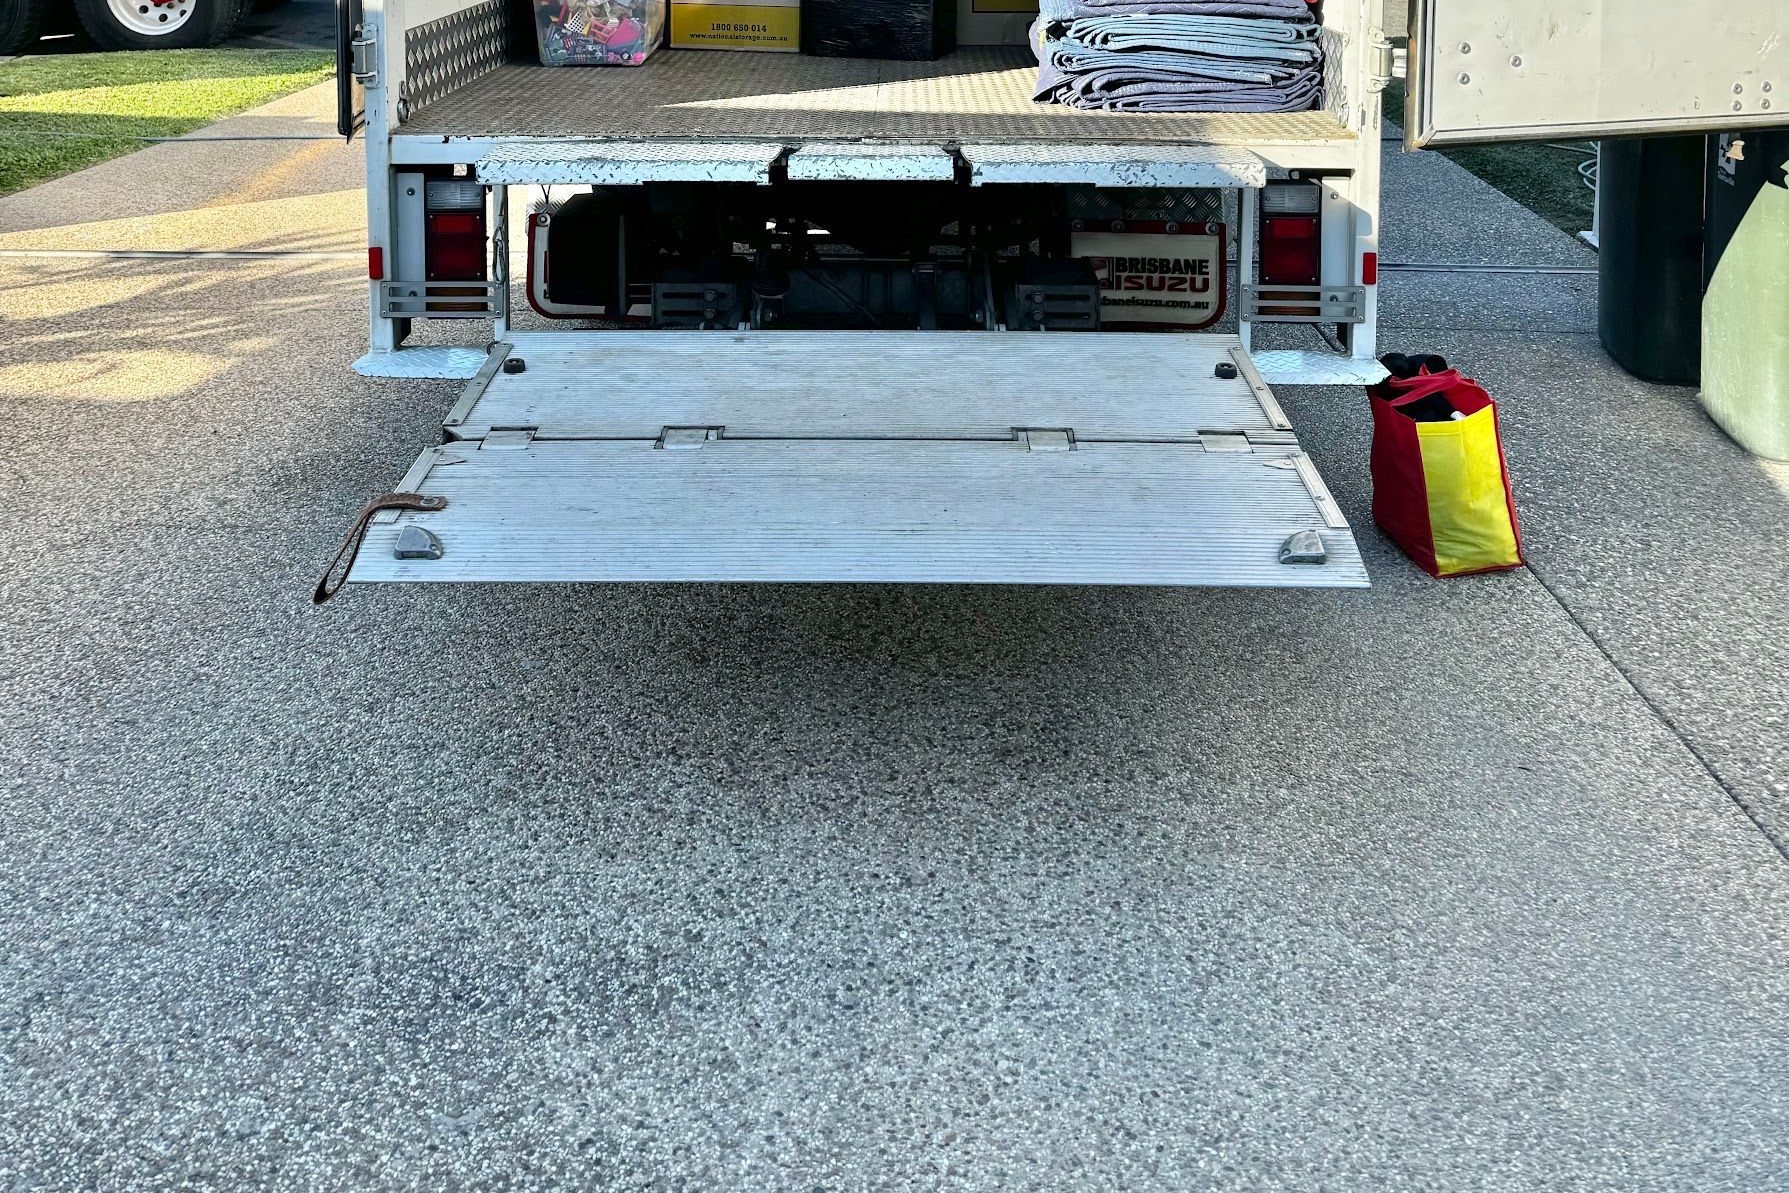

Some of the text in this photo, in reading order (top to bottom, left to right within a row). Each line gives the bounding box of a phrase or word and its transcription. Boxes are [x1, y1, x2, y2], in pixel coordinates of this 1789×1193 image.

[711, 23, 767, 33] 1800 650 014
[689, 33, 788, 41] www.nationalstorage.com.au
[1115, 257, 1209, 275] BRISBANE
[1115, 275, 1209, 293] ISUZU
